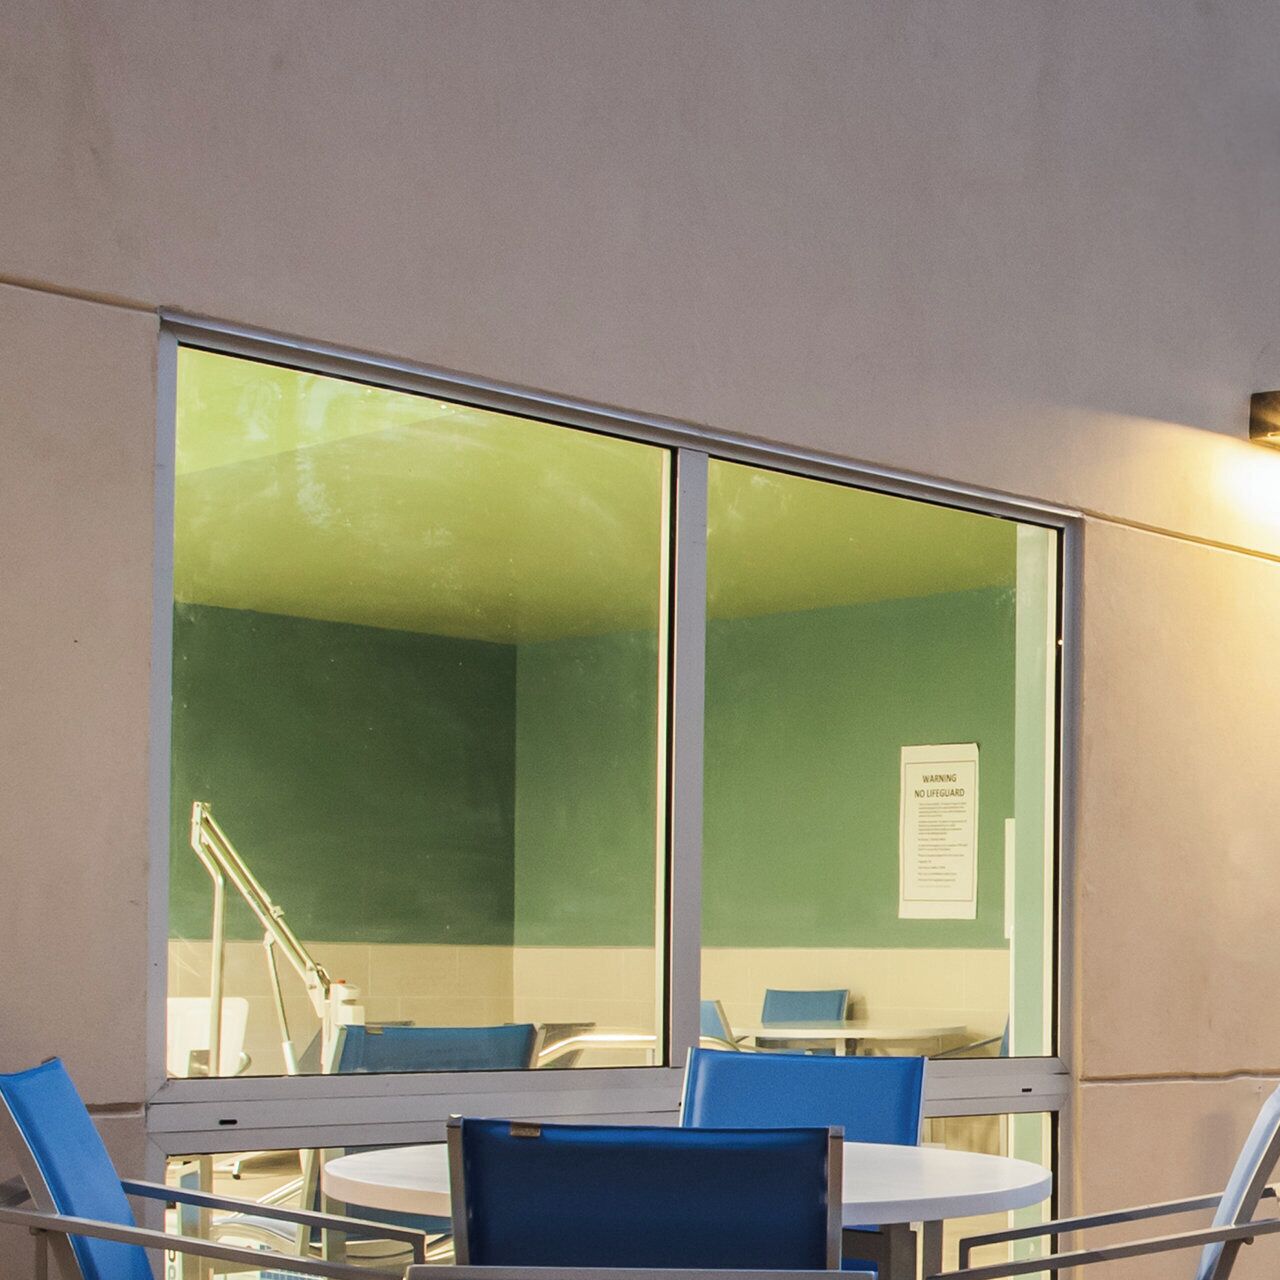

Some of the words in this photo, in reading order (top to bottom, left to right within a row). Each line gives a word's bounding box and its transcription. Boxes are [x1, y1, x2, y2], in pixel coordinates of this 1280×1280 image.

[922, 774, 957, 784] WARNING
[914, 790, 925, 798] NO
[926, 788, 965, 798] LIFEGUARD
